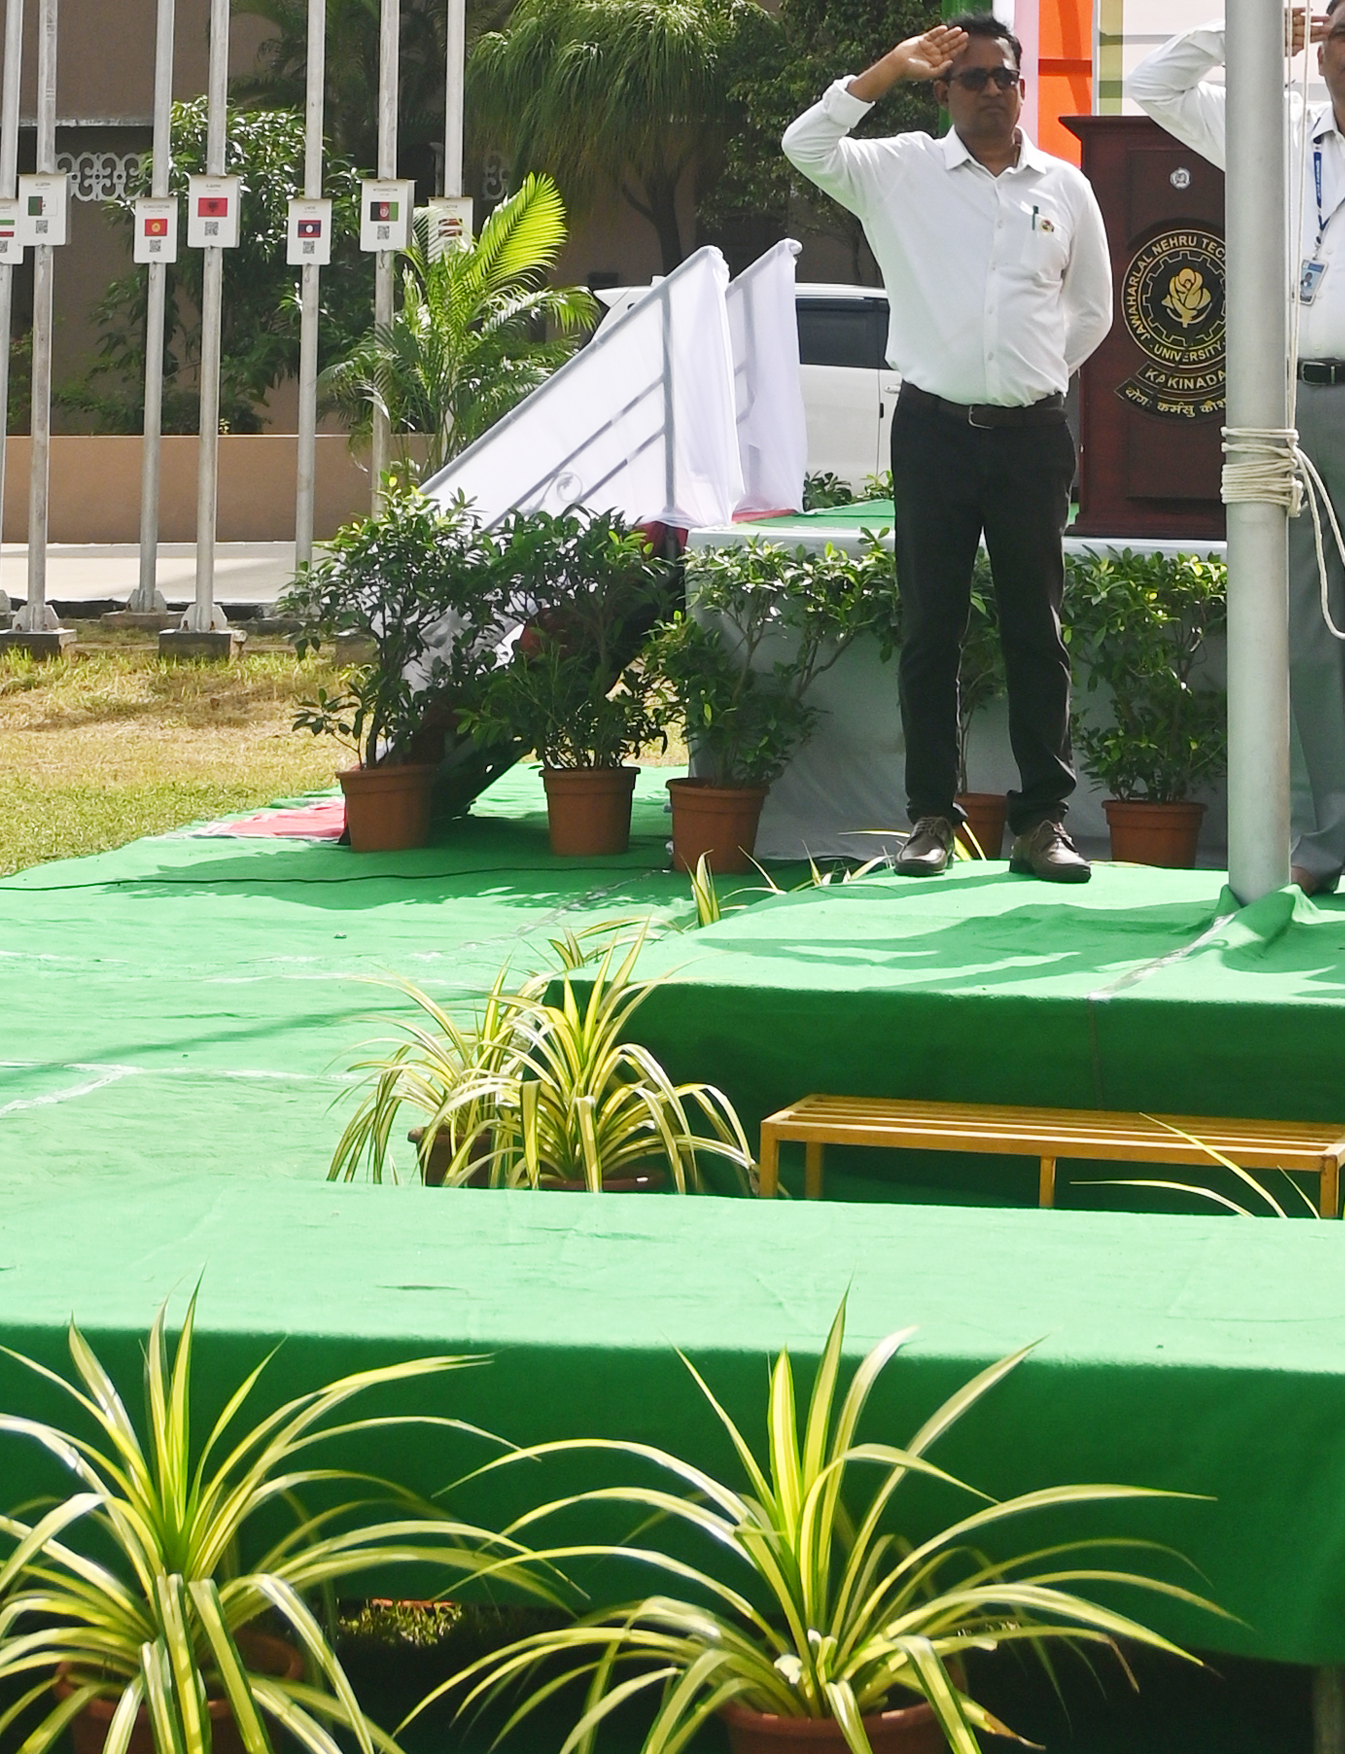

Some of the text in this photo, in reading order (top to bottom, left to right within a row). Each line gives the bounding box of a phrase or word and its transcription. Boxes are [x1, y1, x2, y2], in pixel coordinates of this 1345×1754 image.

[1126, 235, 1198, 341] JAWAHARLAL NEHRU
[1153, 341, 1222, 362] UNIVERSITY
[1145, 368, 1226, 390] KAKINADA
